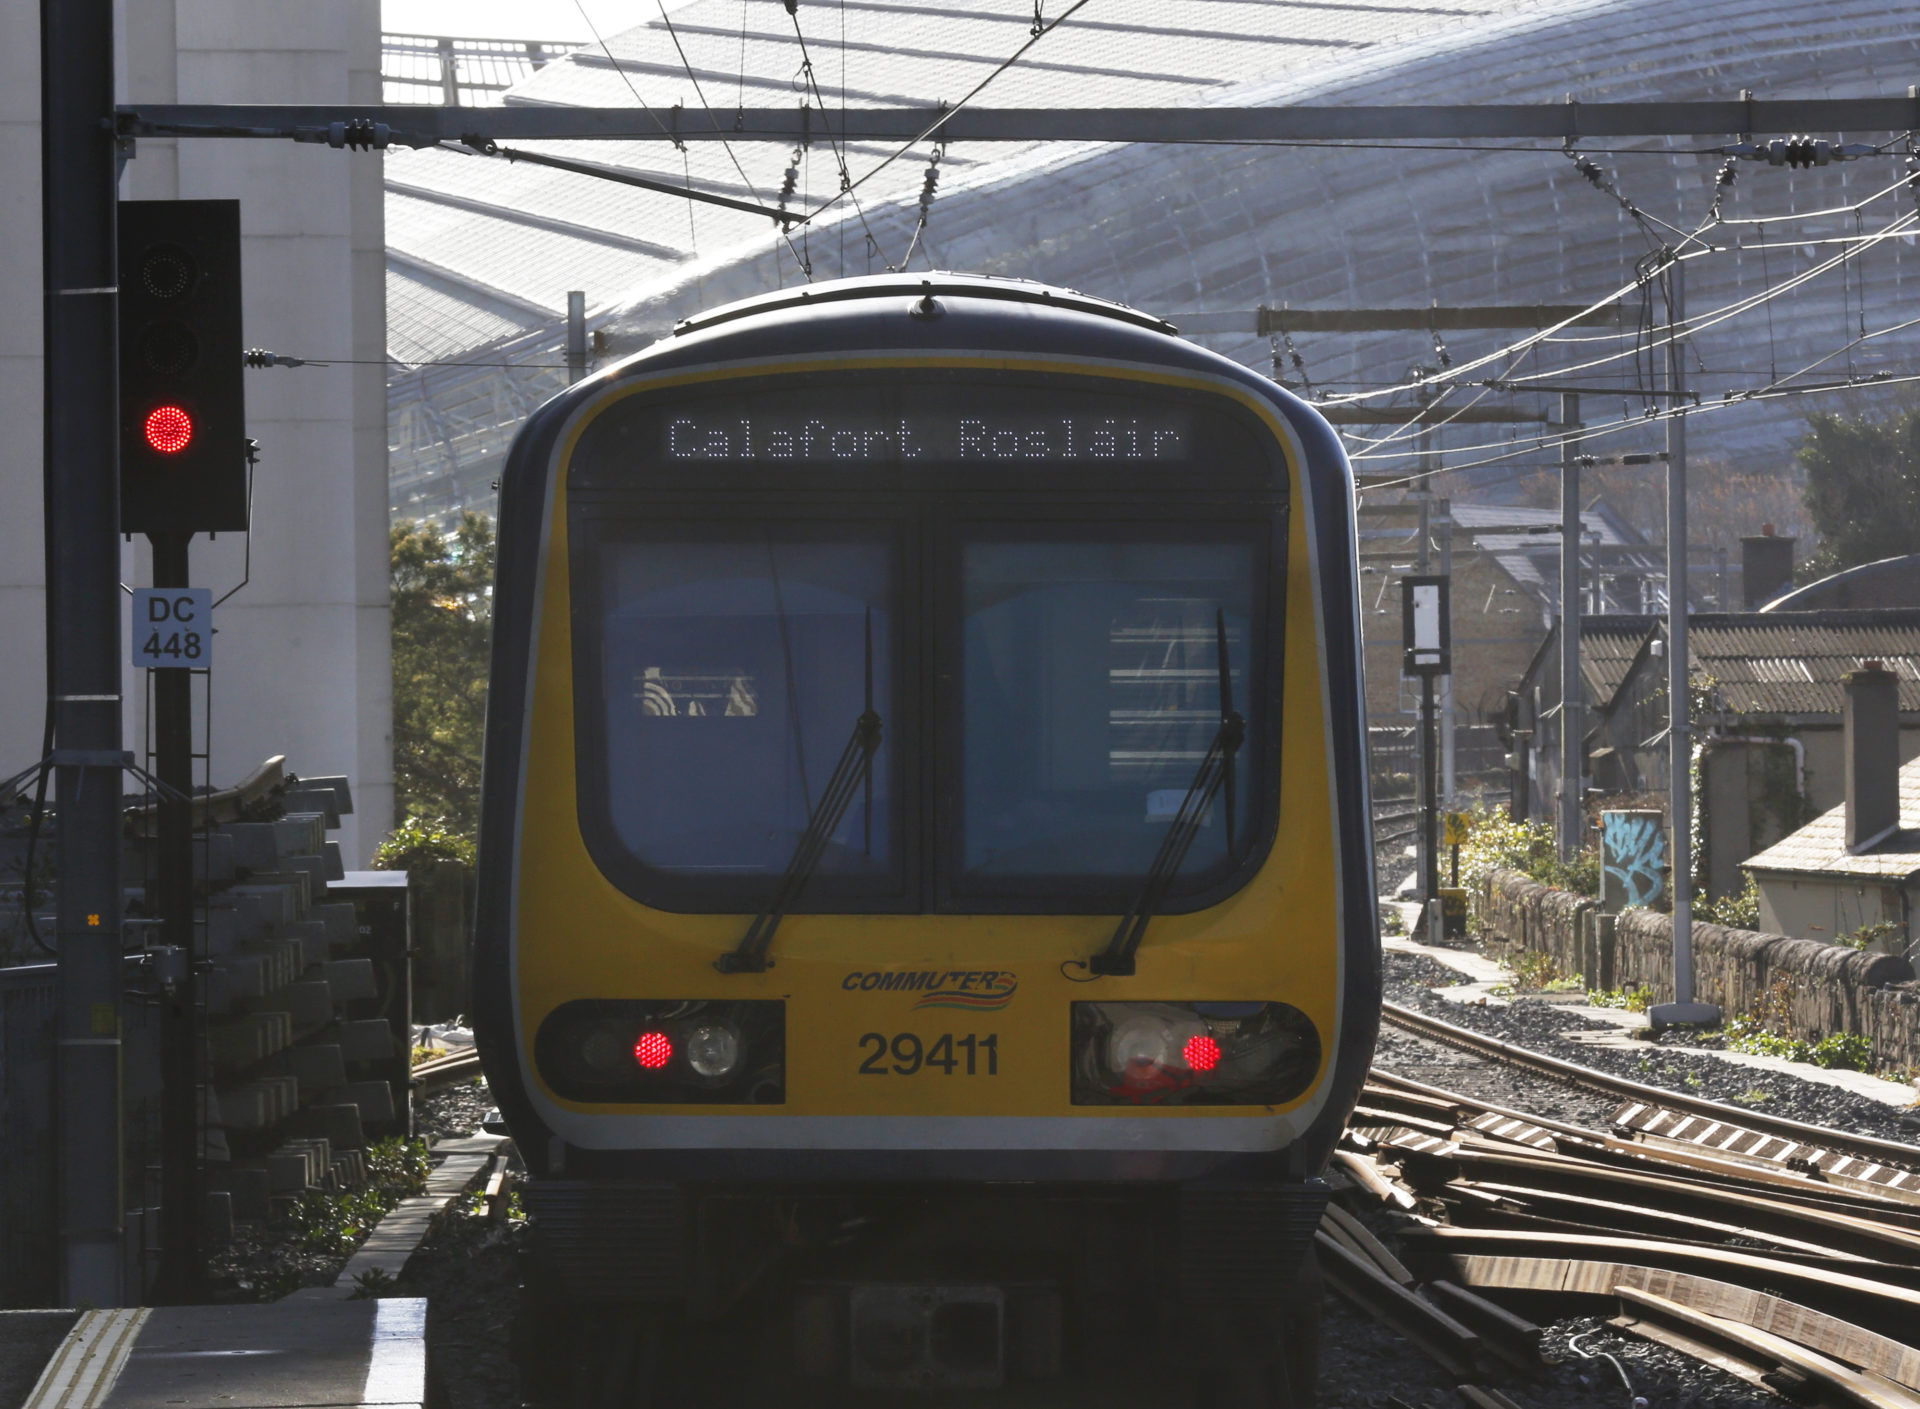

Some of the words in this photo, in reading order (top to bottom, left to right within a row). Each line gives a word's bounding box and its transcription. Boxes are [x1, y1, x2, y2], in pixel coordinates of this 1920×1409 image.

[669, 418, 923, 458] Calafort
[959, 418, 1181, 458] Rosláir
[149, 596, 195, 623] DC
[143, 631, 202, 660] 448
[842, 971, 998, 991] COMMUTER
[858, 1032, 998, 1076] 29411
